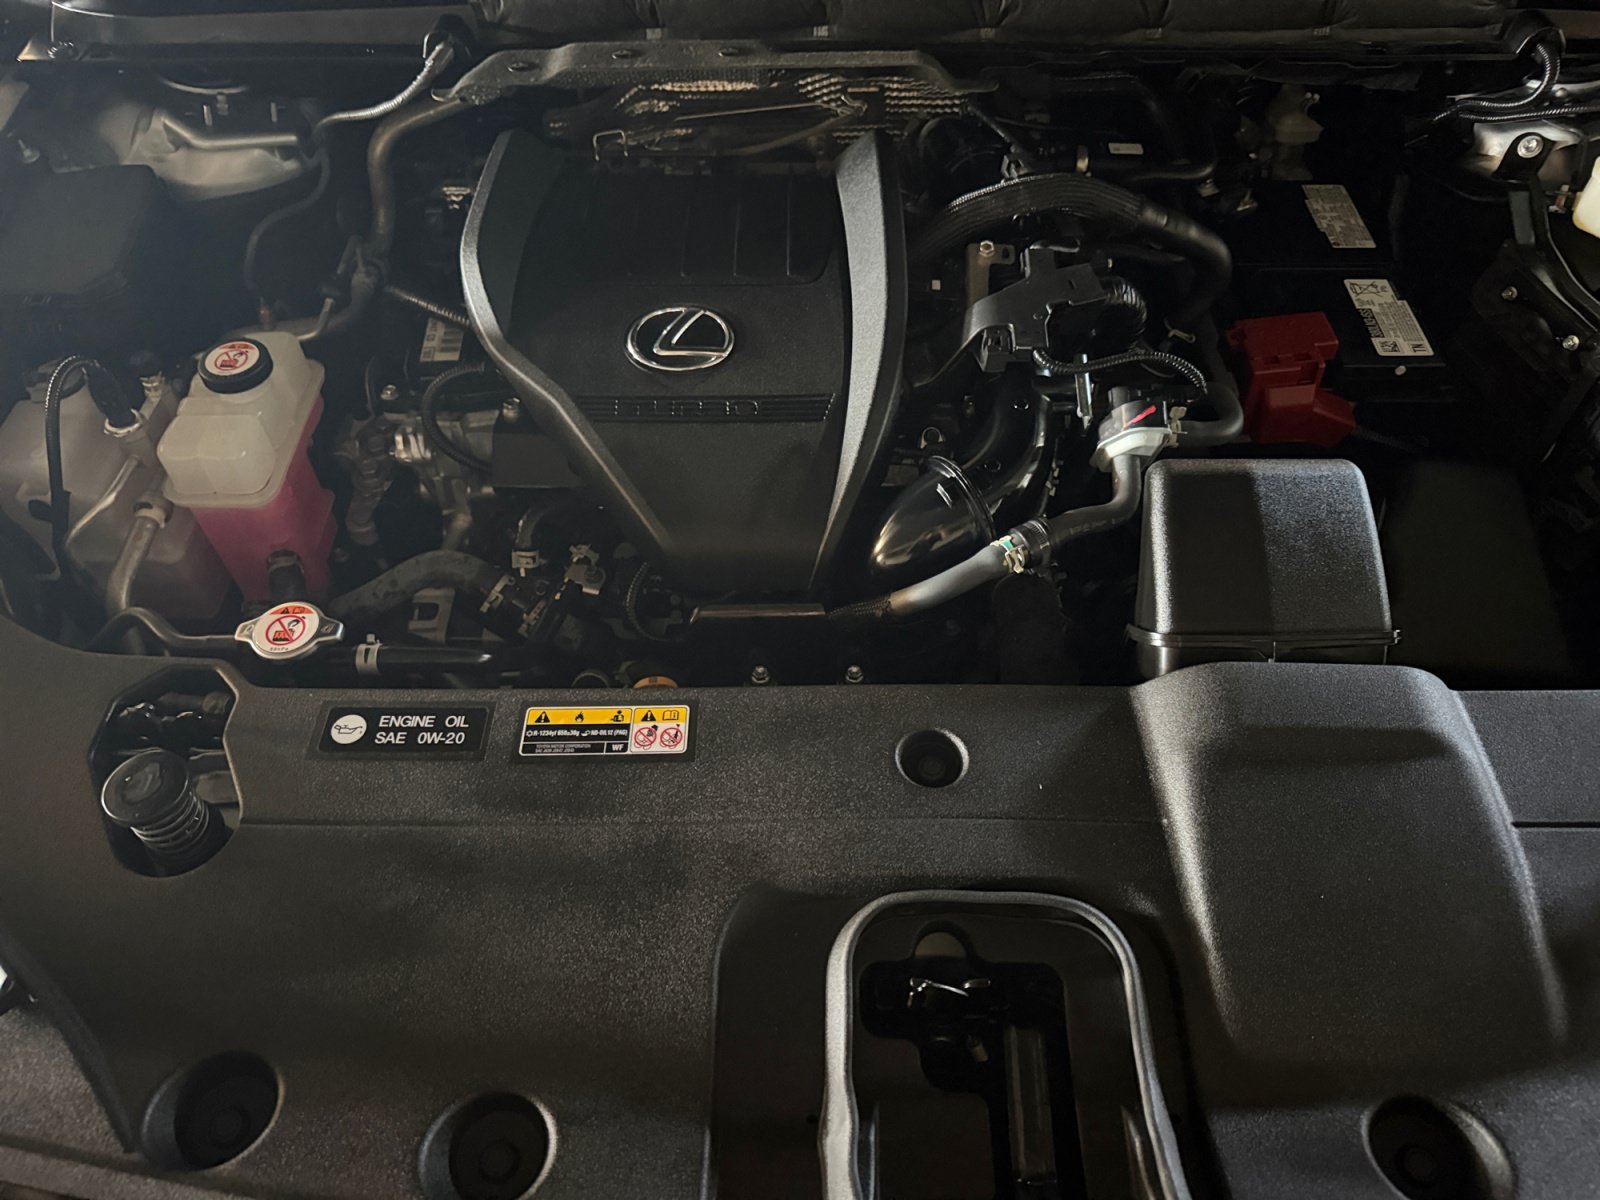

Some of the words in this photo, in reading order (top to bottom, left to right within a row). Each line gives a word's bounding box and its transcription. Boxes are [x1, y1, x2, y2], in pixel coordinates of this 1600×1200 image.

[378, 715, 436, 728] ENGINE
[444, 715, 470, 728] OIL
[374, 731, 408, 744] SAE
[416, 731, 466, 745] 0W-20
[611, 743, 625, 751] WF
